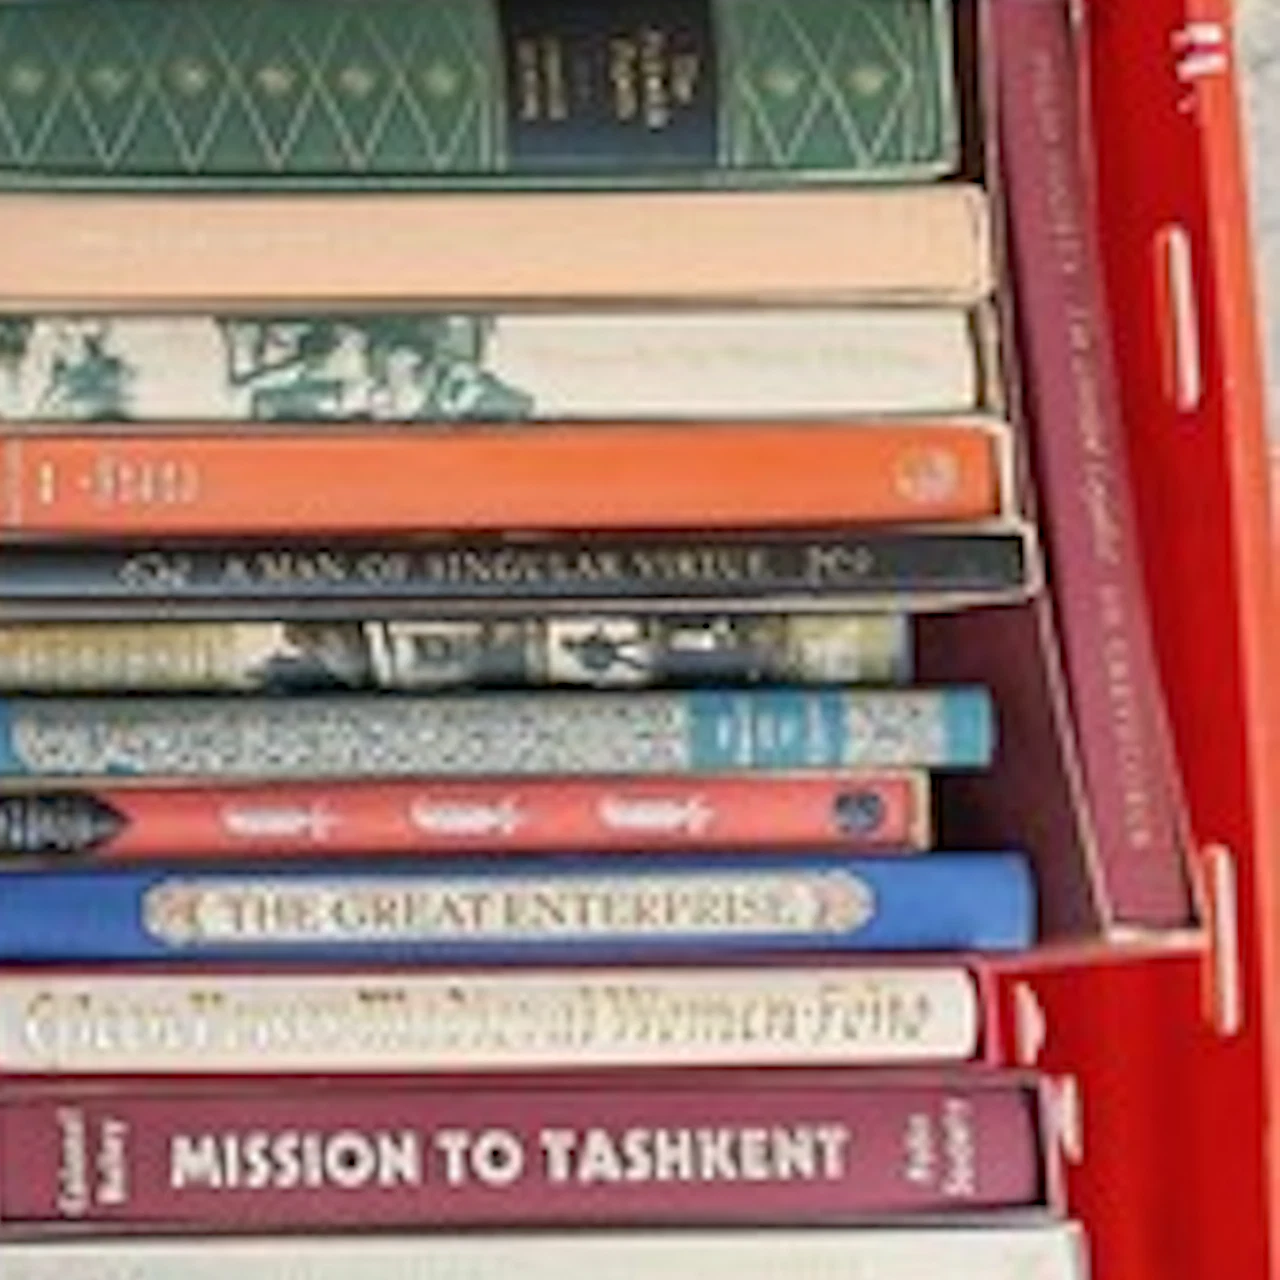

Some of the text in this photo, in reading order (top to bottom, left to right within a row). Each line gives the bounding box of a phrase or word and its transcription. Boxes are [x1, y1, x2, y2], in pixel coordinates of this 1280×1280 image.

[254, 556, 343, 582] MAN
[357, 555, 407, 580] OF
[433, 552, 620, 582] SINGULAR
[640, 551, 765, 580] VIRTUE
[231, 889, 792, 933] THE GREAT ENTERPRISE
[169, 1124, 850, 1192] MISSION TO TASHKENT
